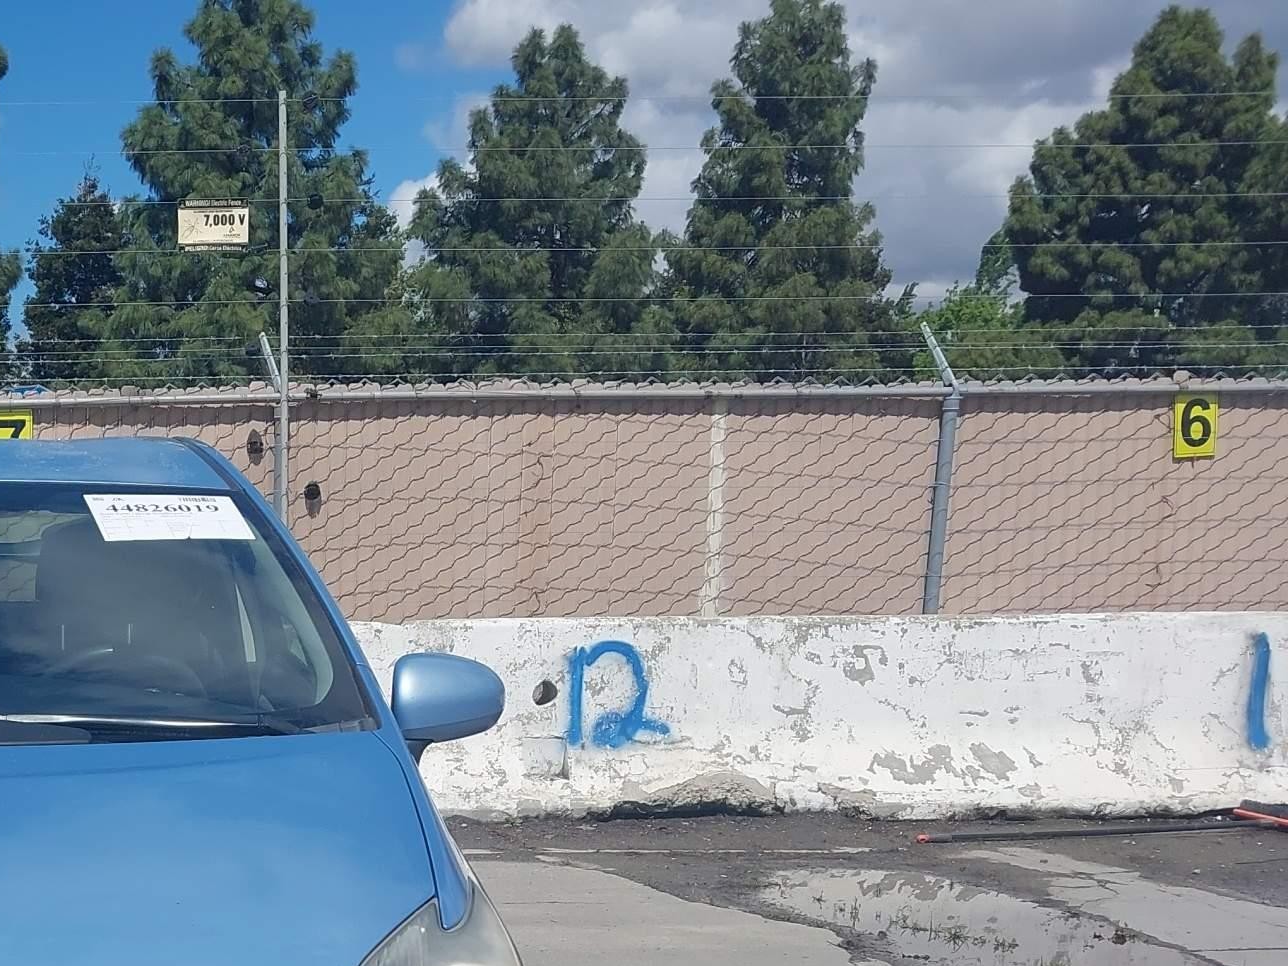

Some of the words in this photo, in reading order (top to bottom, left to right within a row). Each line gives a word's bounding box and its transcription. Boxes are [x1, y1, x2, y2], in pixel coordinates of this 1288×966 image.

[203, 213, 235, 228] 7,000
[238, 213, 246, 226] V
[1181, 397, 1211, 448] 6
[105, 503, 220, 513] 44826019
[567, 640, 671, 749] 12
